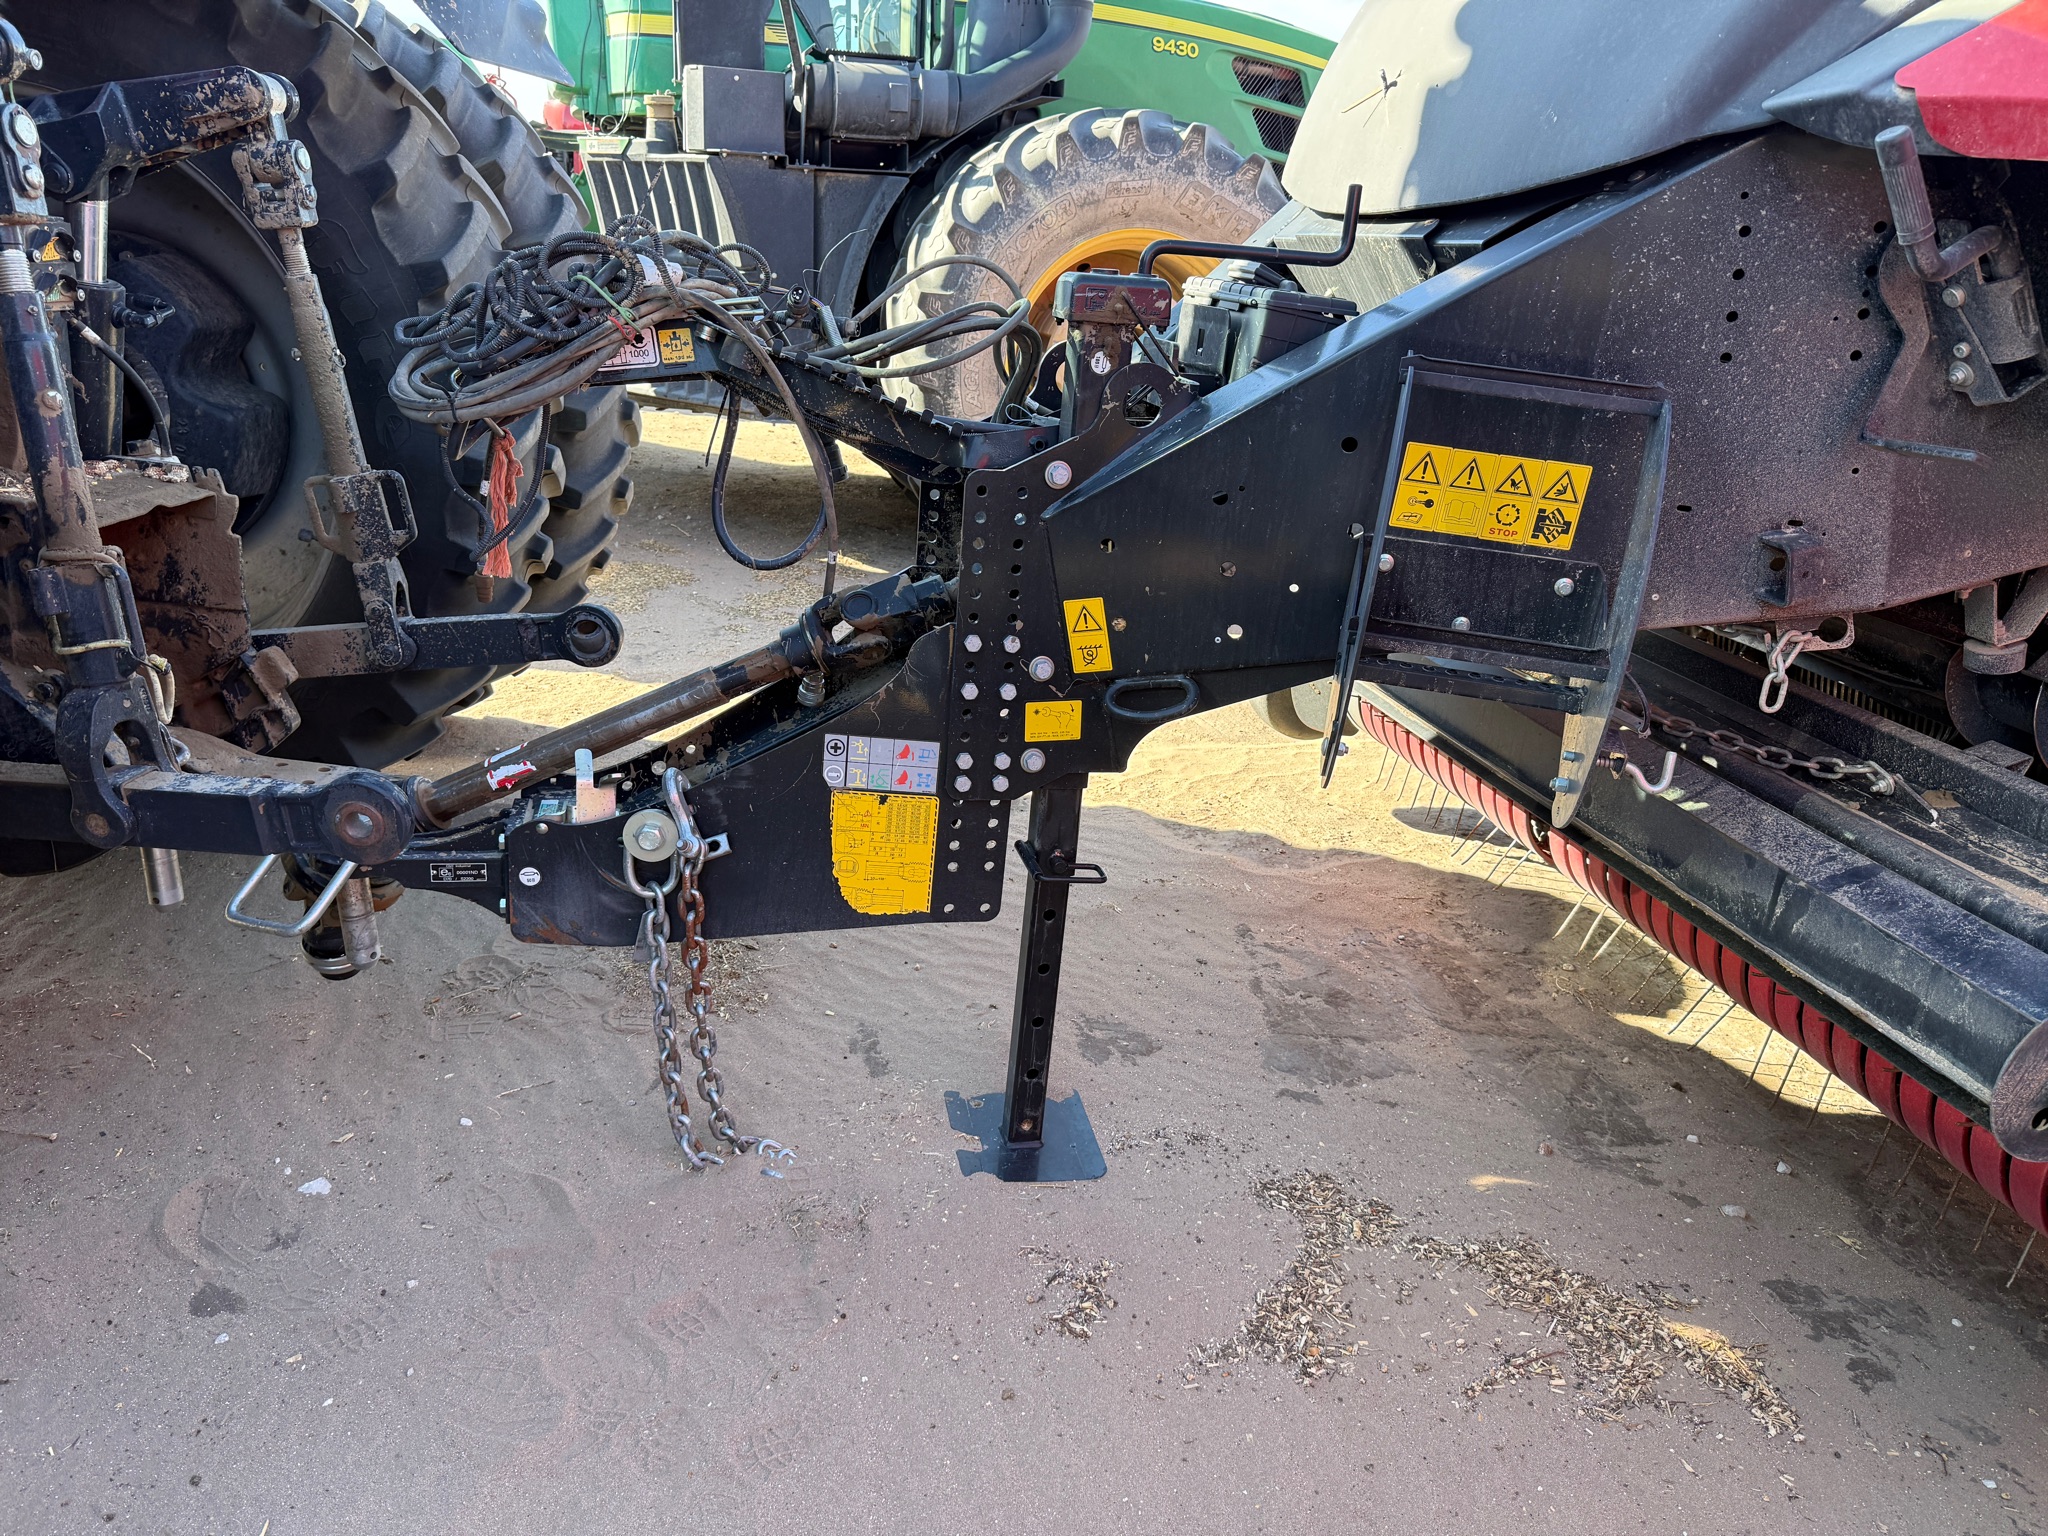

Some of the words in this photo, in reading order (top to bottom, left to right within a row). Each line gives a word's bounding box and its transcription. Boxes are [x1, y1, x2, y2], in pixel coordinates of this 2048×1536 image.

[1151, 36, 1200, 58] 9430
[1179, 186, 1254, 238] BKT
[629, 349, 650, 358] 1000
[1489, 527, 1518, 537] STOP
